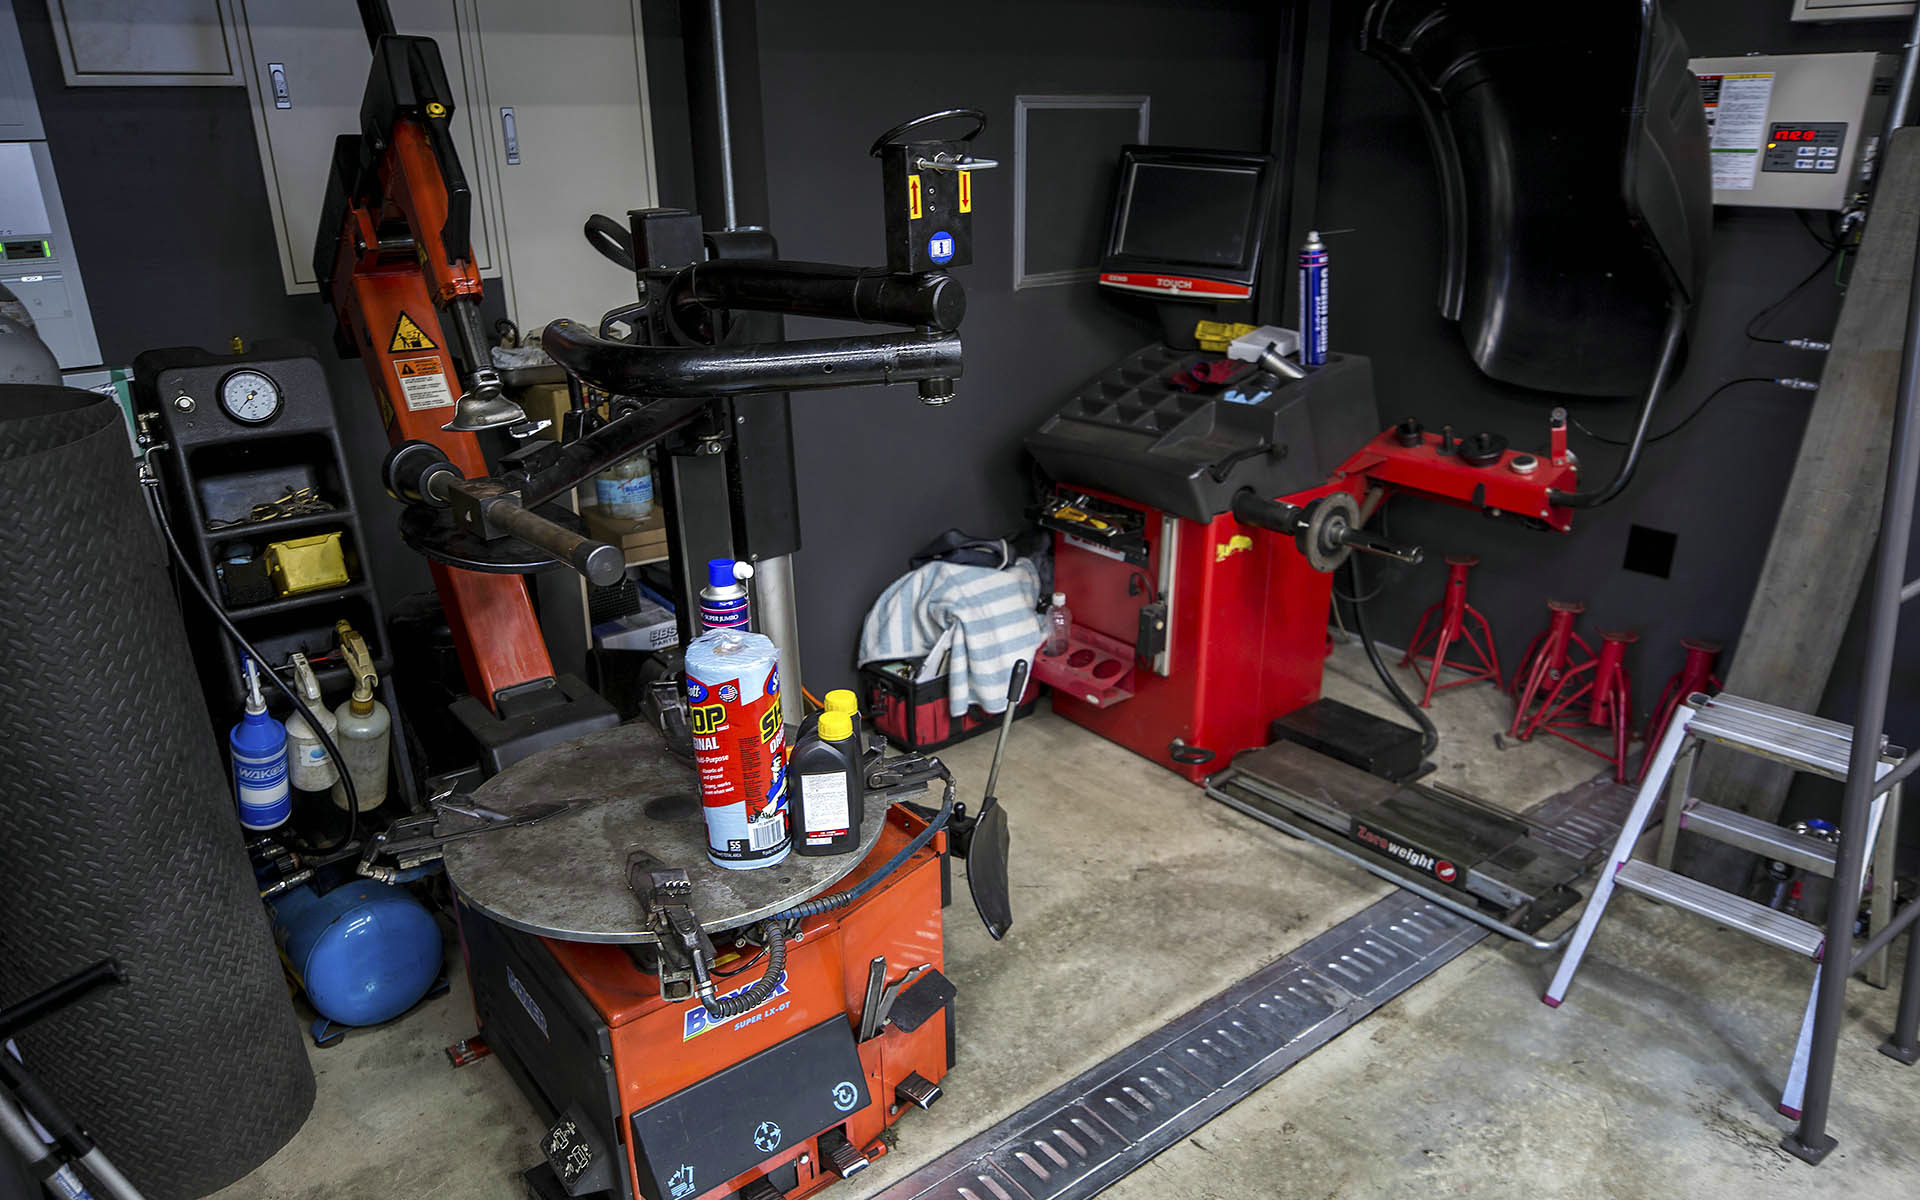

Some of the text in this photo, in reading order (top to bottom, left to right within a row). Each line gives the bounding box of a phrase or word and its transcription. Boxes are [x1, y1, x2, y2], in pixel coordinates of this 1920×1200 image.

[1156, 278, 1193, 289] TOUCH
[719, 614, 739, 622] JUMBO
[650, 627, 678, 642] BBS
[652, 636, 678, 647] PARTS
[734, 1013, 762, 1032] SUPER
